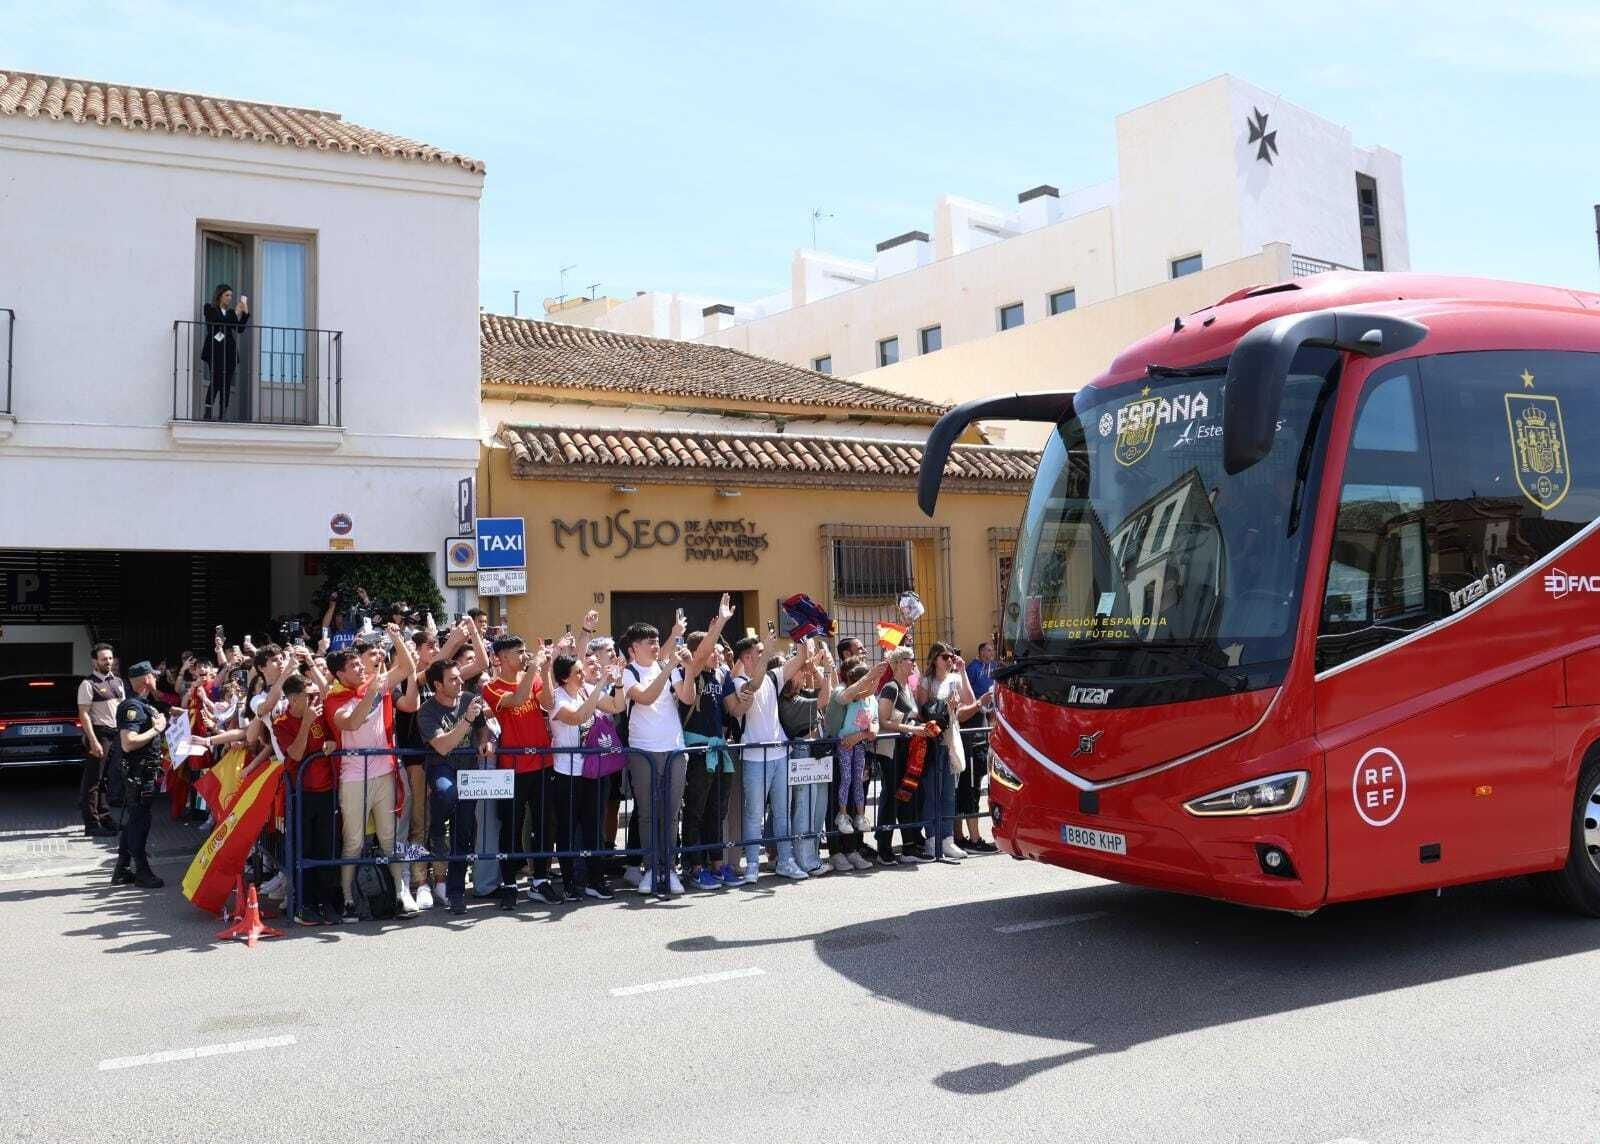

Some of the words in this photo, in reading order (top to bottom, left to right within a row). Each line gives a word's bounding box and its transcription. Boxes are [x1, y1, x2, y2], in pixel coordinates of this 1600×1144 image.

[1117, 391, 1209, 434] ESPAÑA
[461, 481, 469, 521] P
[551, 508, 681, 559] MUSEO
[684, 520, 701, 533] DE
[704, 518, 745, 534] ARTES
[748, 522, 757, 533] Y
[480, 535, 523, 551] TAXI
[684, 533, 769, 550] COSTUMBRES
[684, 548, 760, 565] POPULARES
[17, 573, 40, 603] P
[10, 603, 45, 613] HOTEL
[1041, 617, 1099, 629] SELECCIÓN
[1102, 615, 1168, 627] ESPAÑOLA
[1068, 630, 1081, 639] DE
[1086, 628, 1131, 639] FÚTBOL
[489, 787, 513, 796] LOCAL
[1068, 828, 1096, 846] 8806
[1099, 833, 1122, 850] KHP
